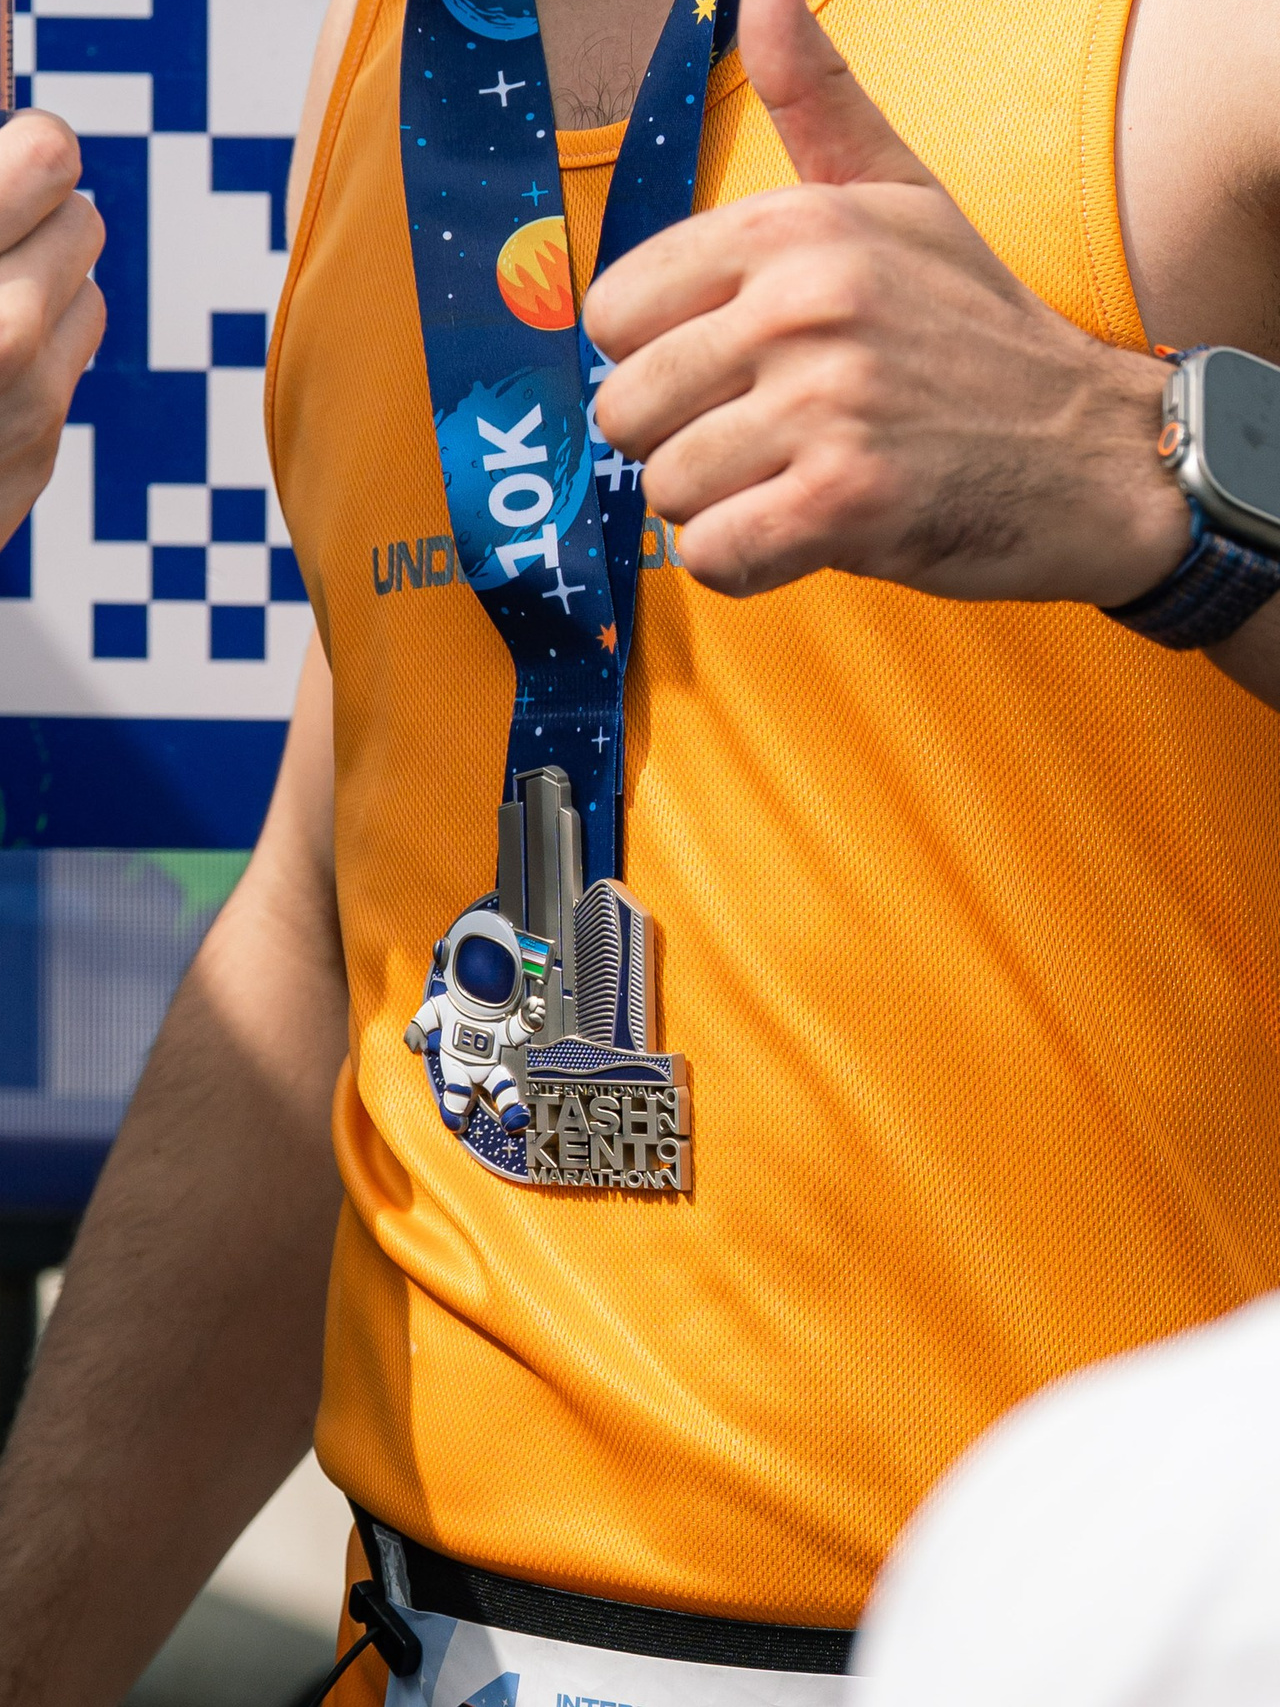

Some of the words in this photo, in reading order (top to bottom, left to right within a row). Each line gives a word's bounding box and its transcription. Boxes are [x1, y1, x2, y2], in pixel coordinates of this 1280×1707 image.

[476, 402, 560, 579] 10K
[528, 1082, 658, 1098] INTERNATIONAL
[525, 1093, 658, 1140] TASH
[525, 1130, 659, 1171] KENT
[529, 1166, 662, 1189] MARATHON
